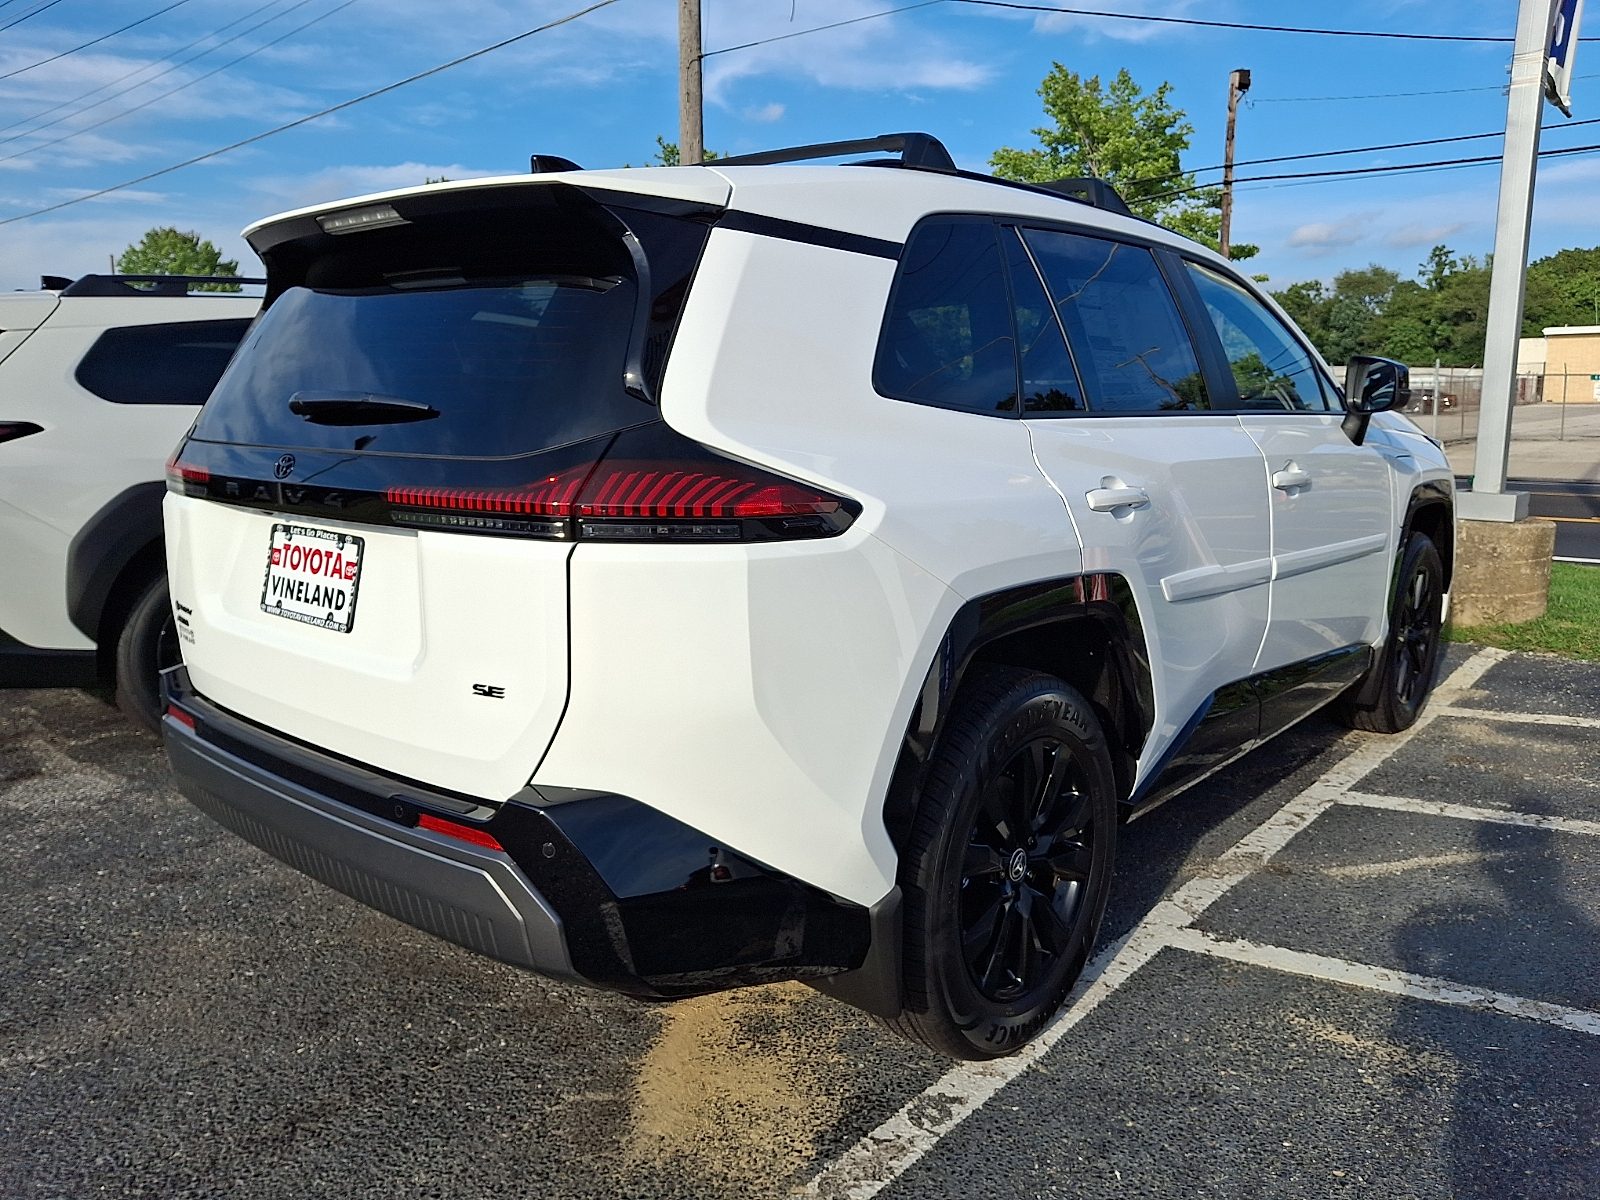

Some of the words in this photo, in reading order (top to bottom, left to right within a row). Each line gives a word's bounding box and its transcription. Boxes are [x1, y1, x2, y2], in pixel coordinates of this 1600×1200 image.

[225, 481, 346, 508] RAV4
[306, 528, 315, 537] Go
[316, 529, 339, 541] Places
[283, 543, 343, 580] TOYOTA
[272, 575, 346, 611] VINELAND
[472, 683, 506, 699] SE
